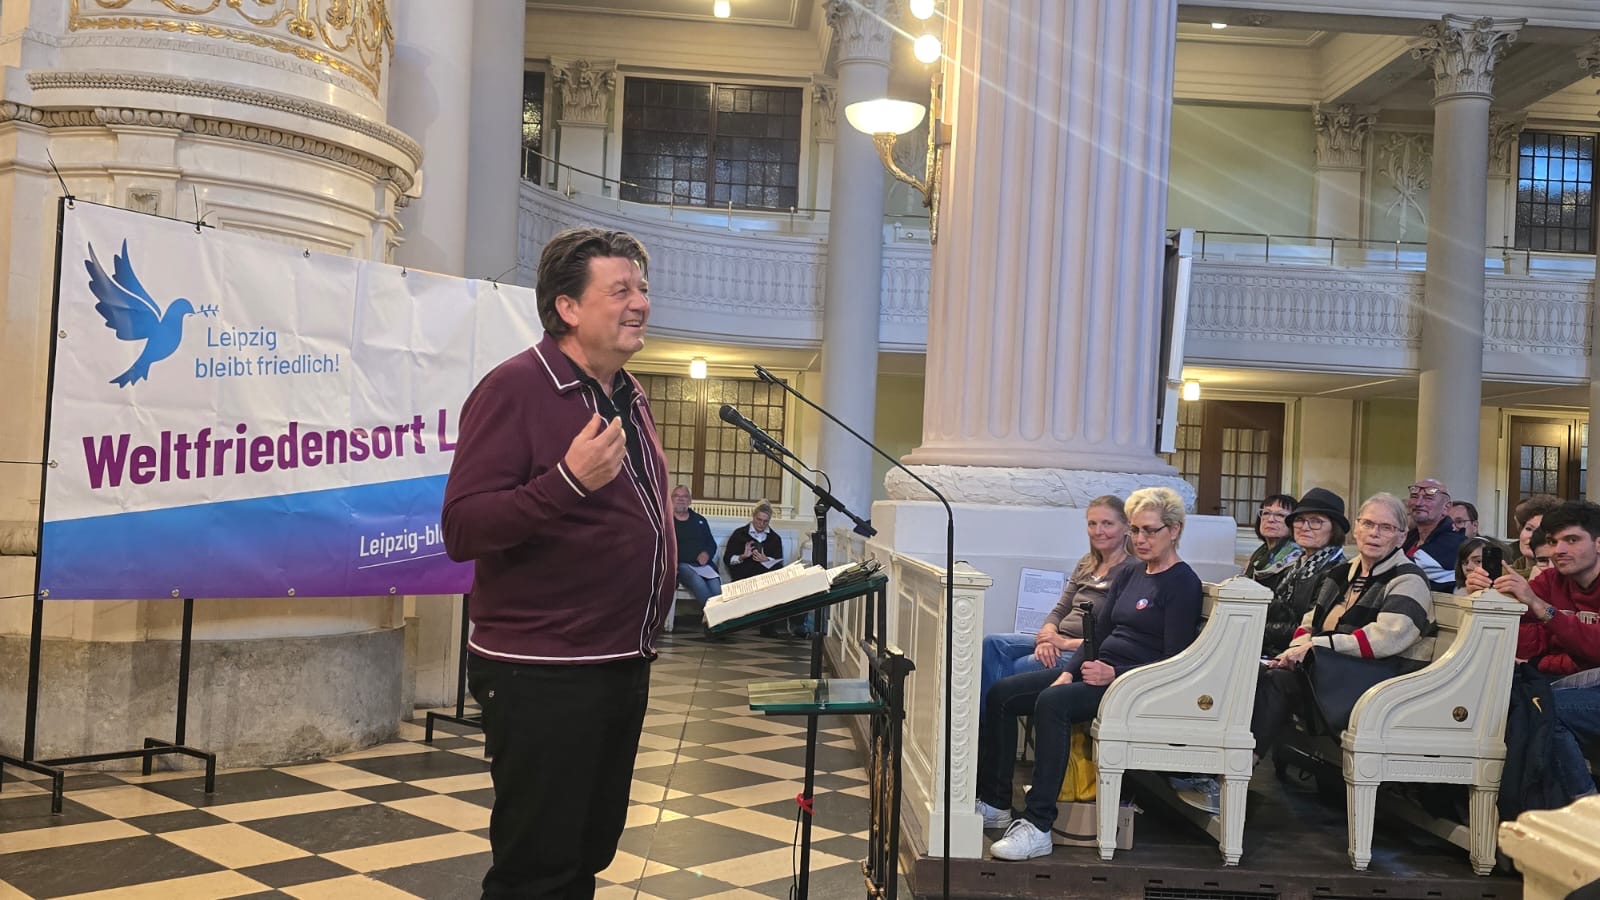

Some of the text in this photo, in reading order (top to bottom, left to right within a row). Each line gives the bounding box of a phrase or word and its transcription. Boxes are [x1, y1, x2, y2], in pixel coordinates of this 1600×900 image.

[207, 326, 277, 351] Leipzig
[195, 353, 340, 378] bleibt friedlich!
[83, 415, 426, 489] Weltfriedensort
